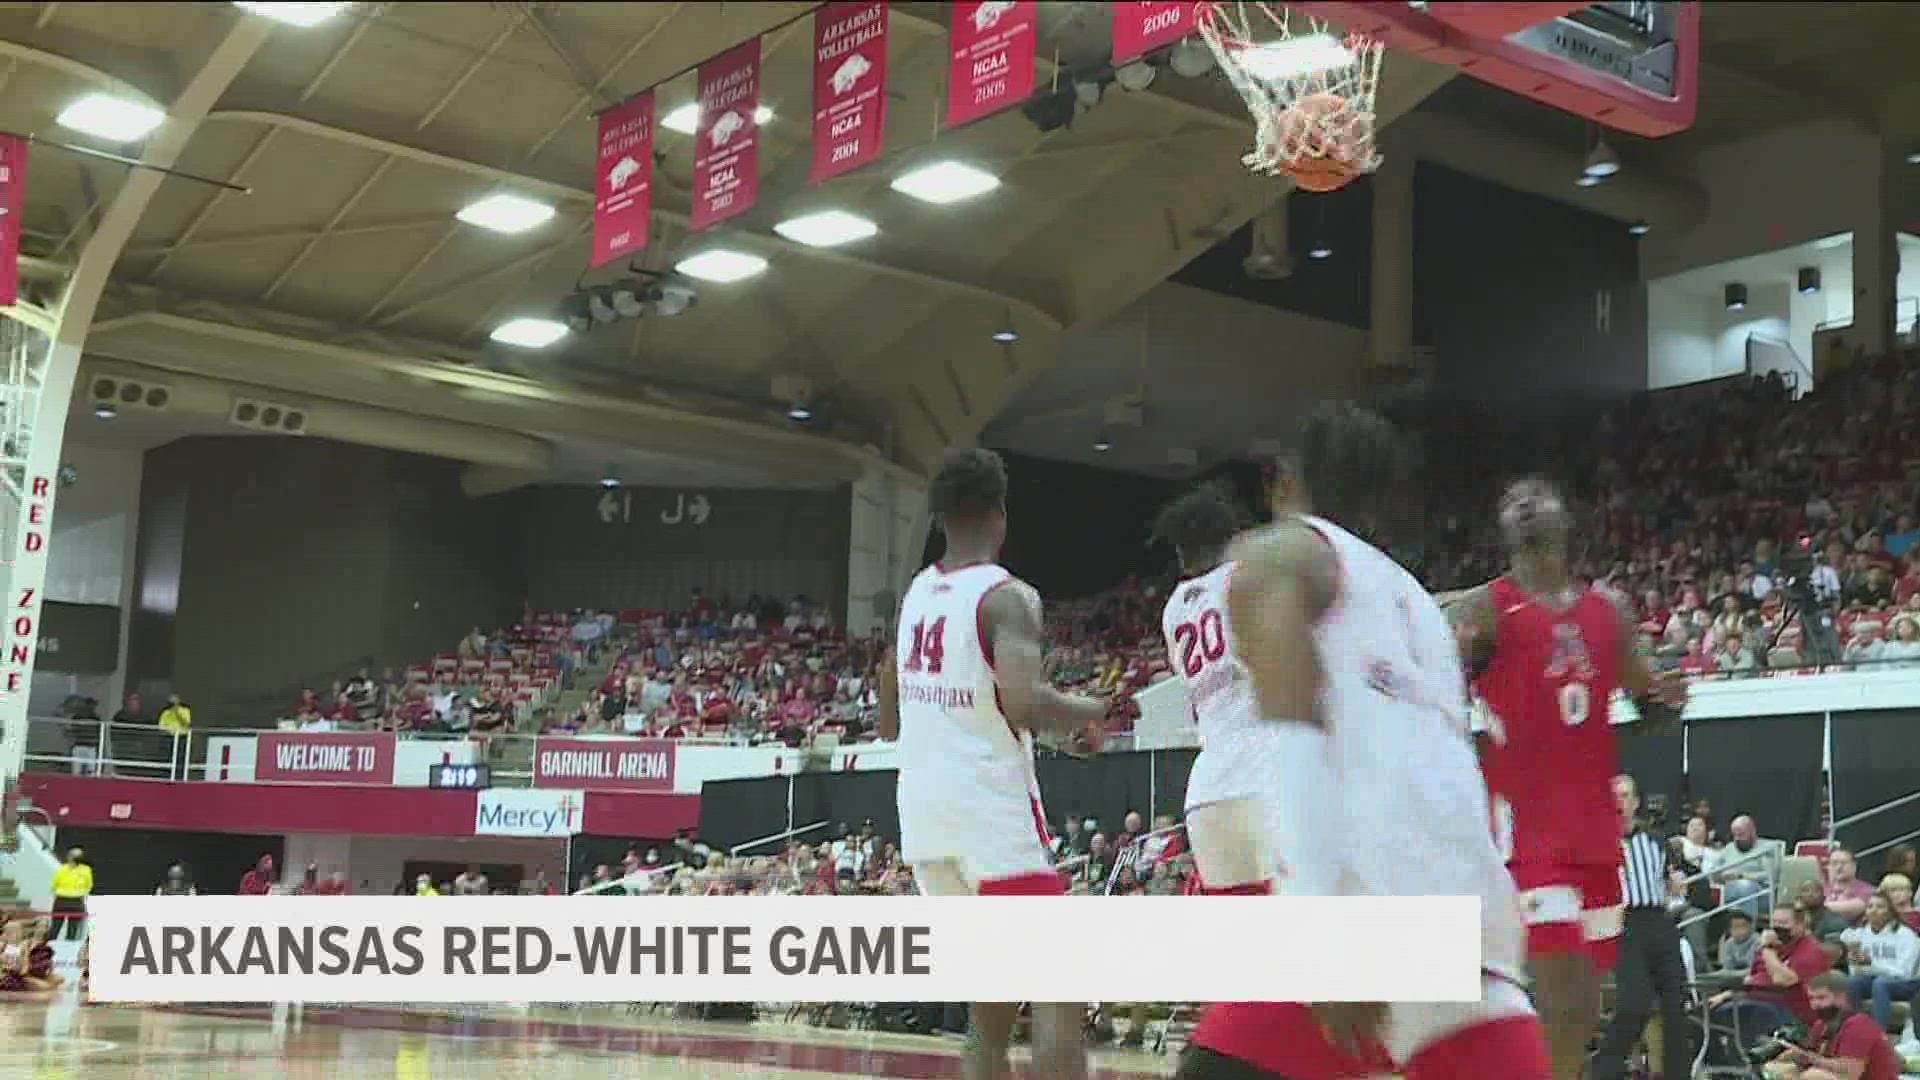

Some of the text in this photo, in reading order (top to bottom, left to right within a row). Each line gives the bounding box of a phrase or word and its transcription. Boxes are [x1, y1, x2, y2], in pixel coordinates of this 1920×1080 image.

[823, 4, 881, 43] ARKANSAS
[818, 22, 883, 62] VOLLEYBALL
[973, 51, 1007, 77] NCAA
[832, 113, 862, 139] NCAA
[832, 139, 859, 164] 2004
[661, 493, 685, 524] J
[7, 477, 49, 691] RED ZONE
[904, 615, 947, 675] 14
[1174, 608, 1225, 678] 20
[1558, 682, 1589, 725] 0
[276, 743, 375, 772] WELCOME TO
[541, 751, 667, 779] BARNHILL ARENA
[478, 803, 558, 832] Mercy
